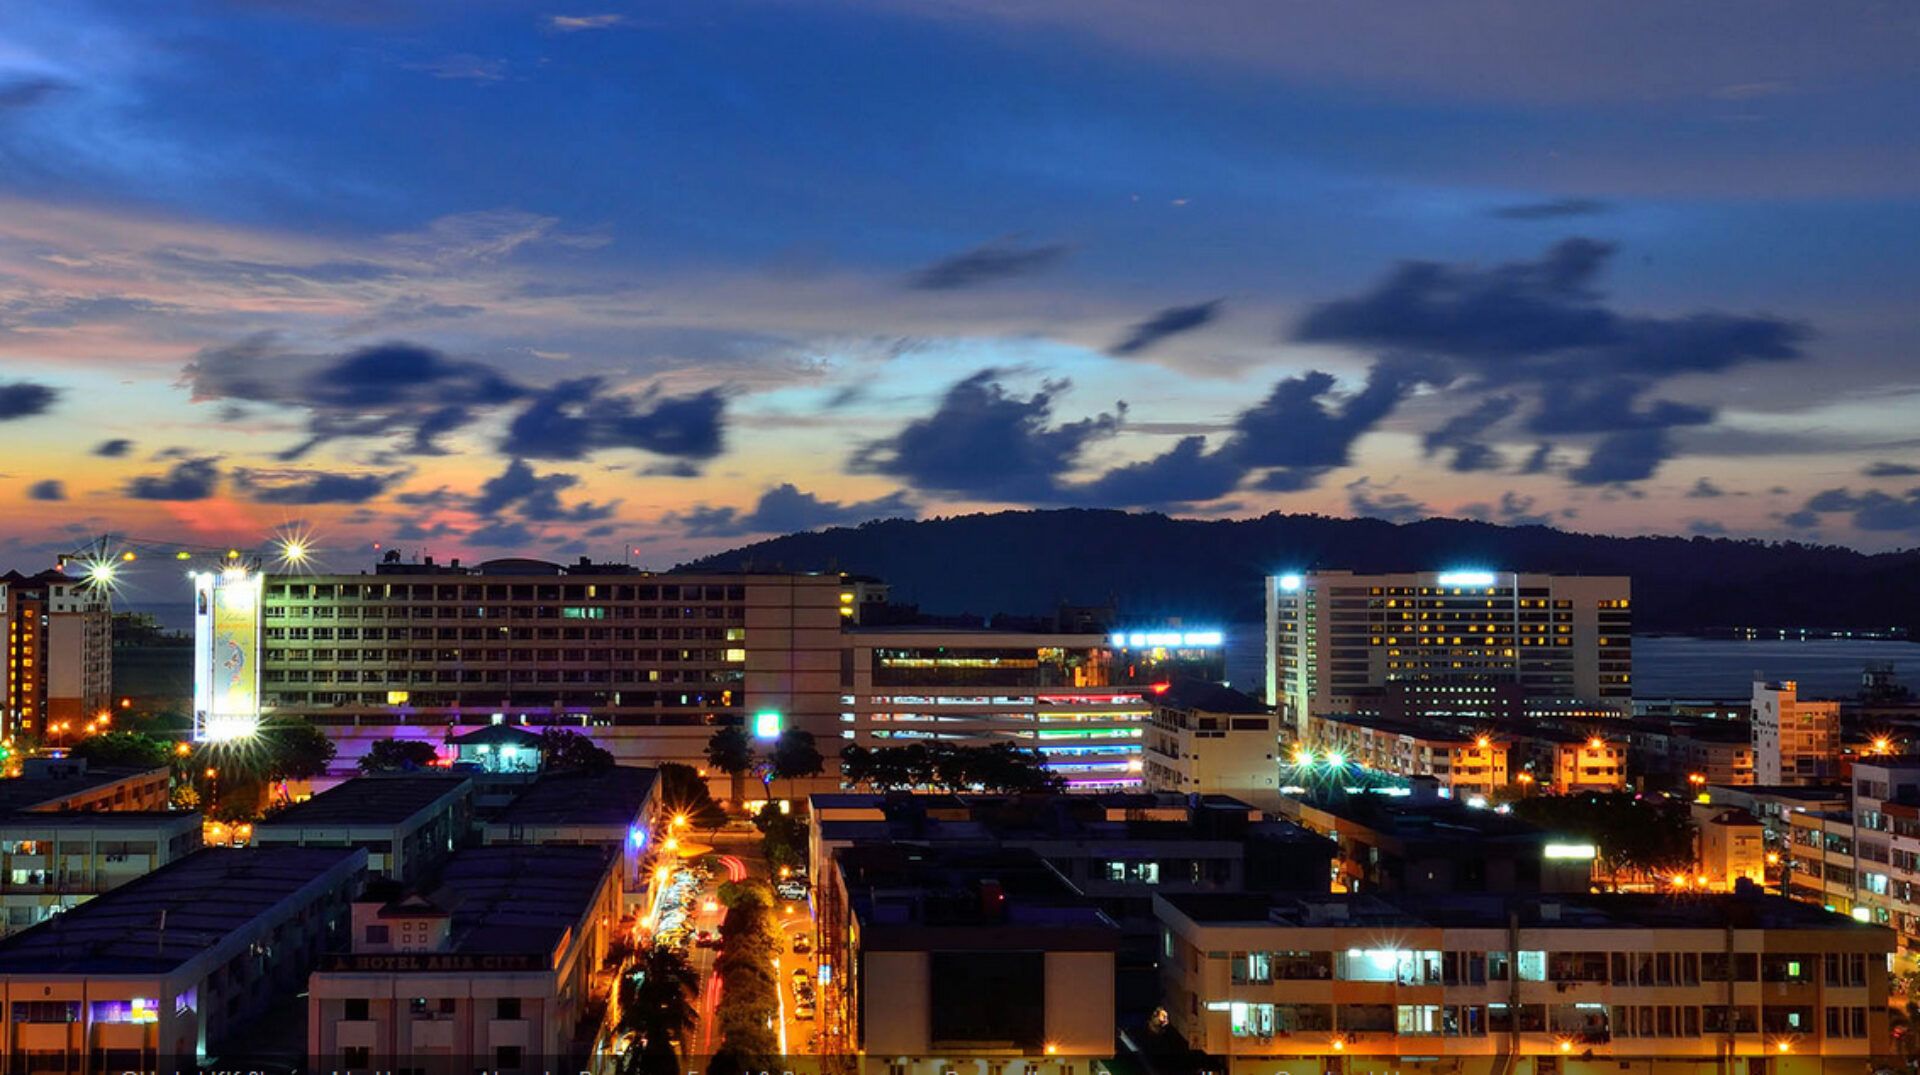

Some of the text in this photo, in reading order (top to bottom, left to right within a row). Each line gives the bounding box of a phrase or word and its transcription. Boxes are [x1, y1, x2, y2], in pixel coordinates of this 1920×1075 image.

[357, 956, 530, 970] HOTEL ASIA CITY
